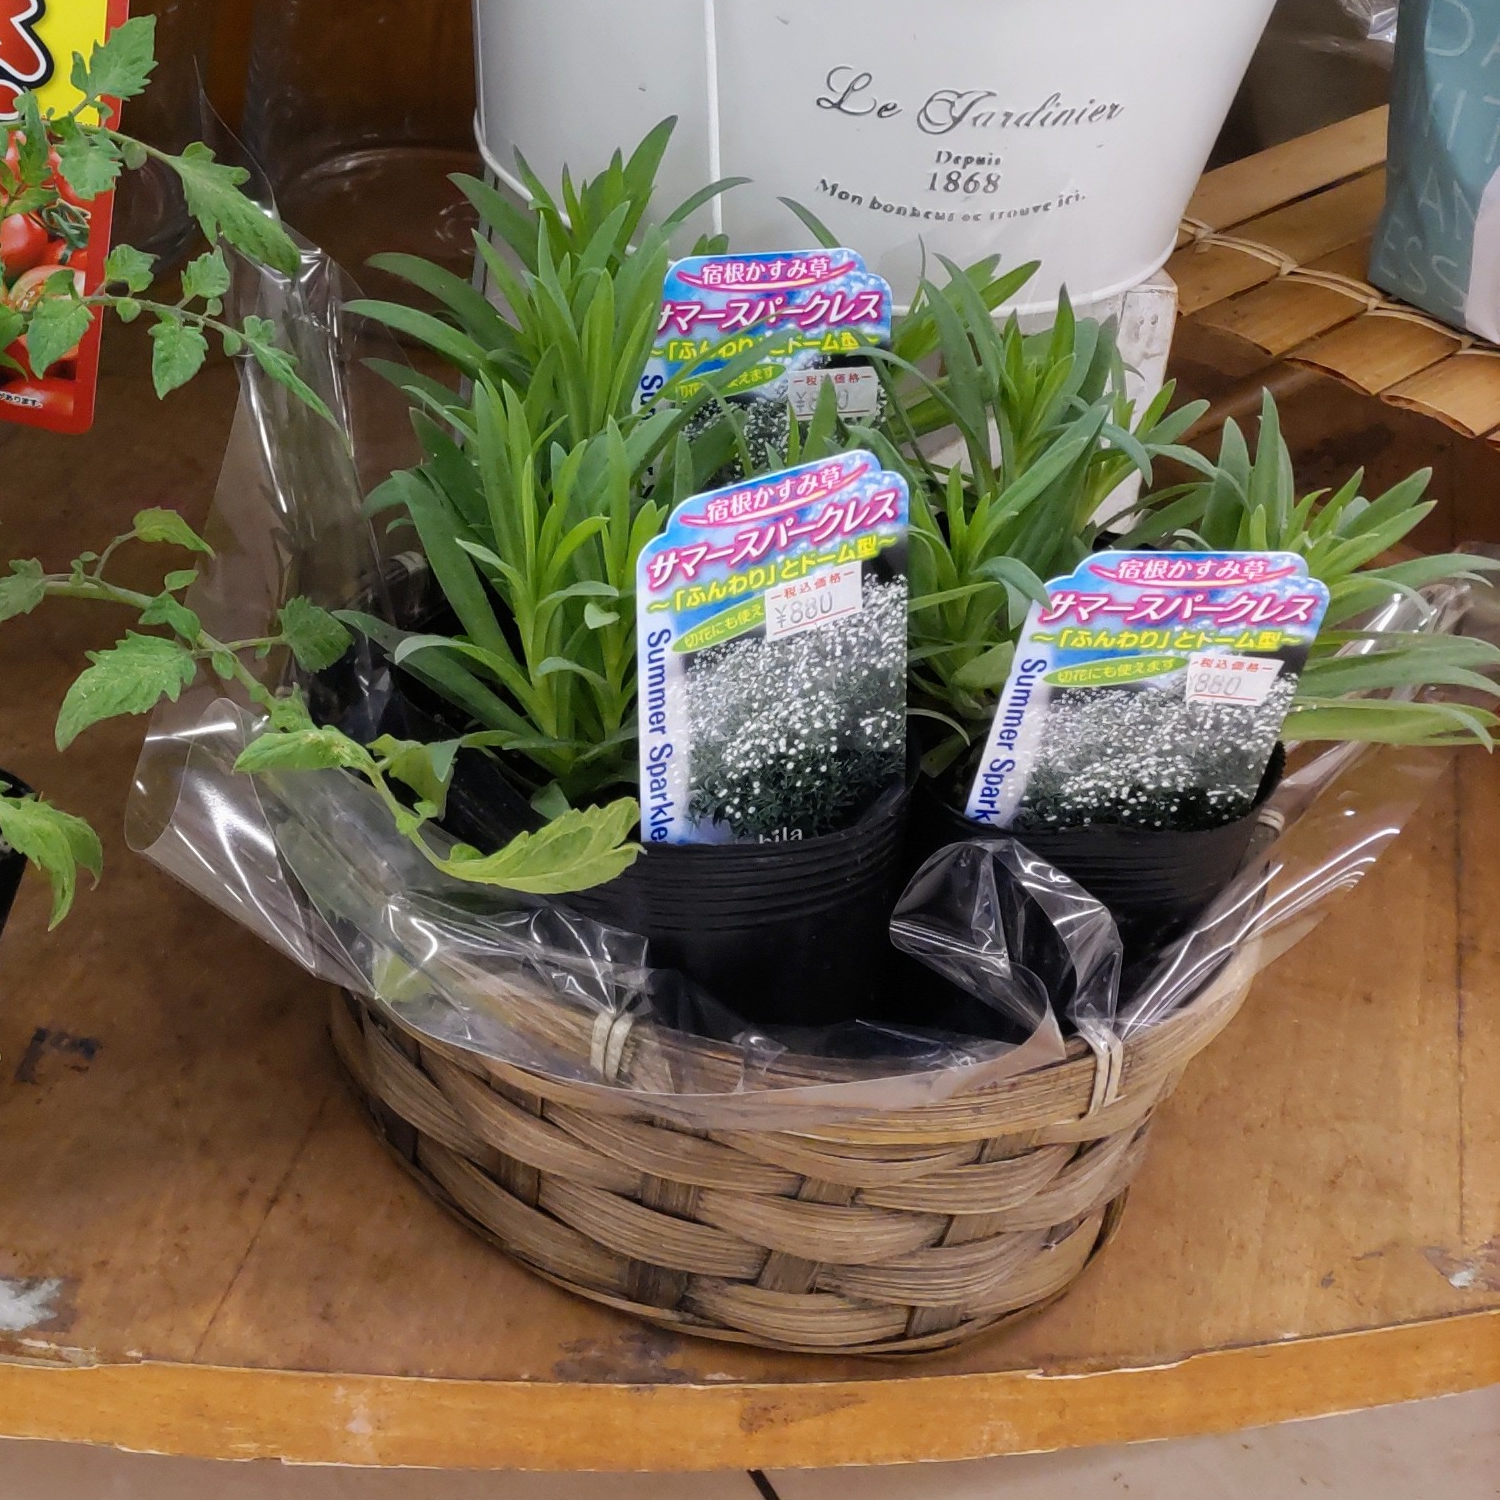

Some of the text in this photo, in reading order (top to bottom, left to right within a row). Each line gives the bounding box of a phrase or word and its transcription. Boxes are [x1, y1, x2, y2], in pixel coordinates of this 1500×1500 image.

[816, 66, 1125, 135] Le Jardinier
[815, 178, 863, 207] Mon
[927, 170, 1002, 195] 1868
[702, 257, 829, 285] 宿根かすみ草
[806, 372, 860, 386] 税価格
[706, 465, 842, 524] 宿根かすみ草
[649, 491, 897, 589] サマースパークレス
[1118, 559, 1268, 580] 宿根かすみ草
[784, 572, 842, 599] 税込価格
[775, 591, 834, 628] ¥880
[1043, 593, 1315, 624] サマースパークレス
[683, 603, 765, 648] 切花にも使え
[1057, 658, 1176, 683] 切花にも使えます
[1201, 658, 1260, 673] 税込価格
[647, 627, 675, 842] Summer Sparkle
[974, 658, 1047, 822] Summer Spark
